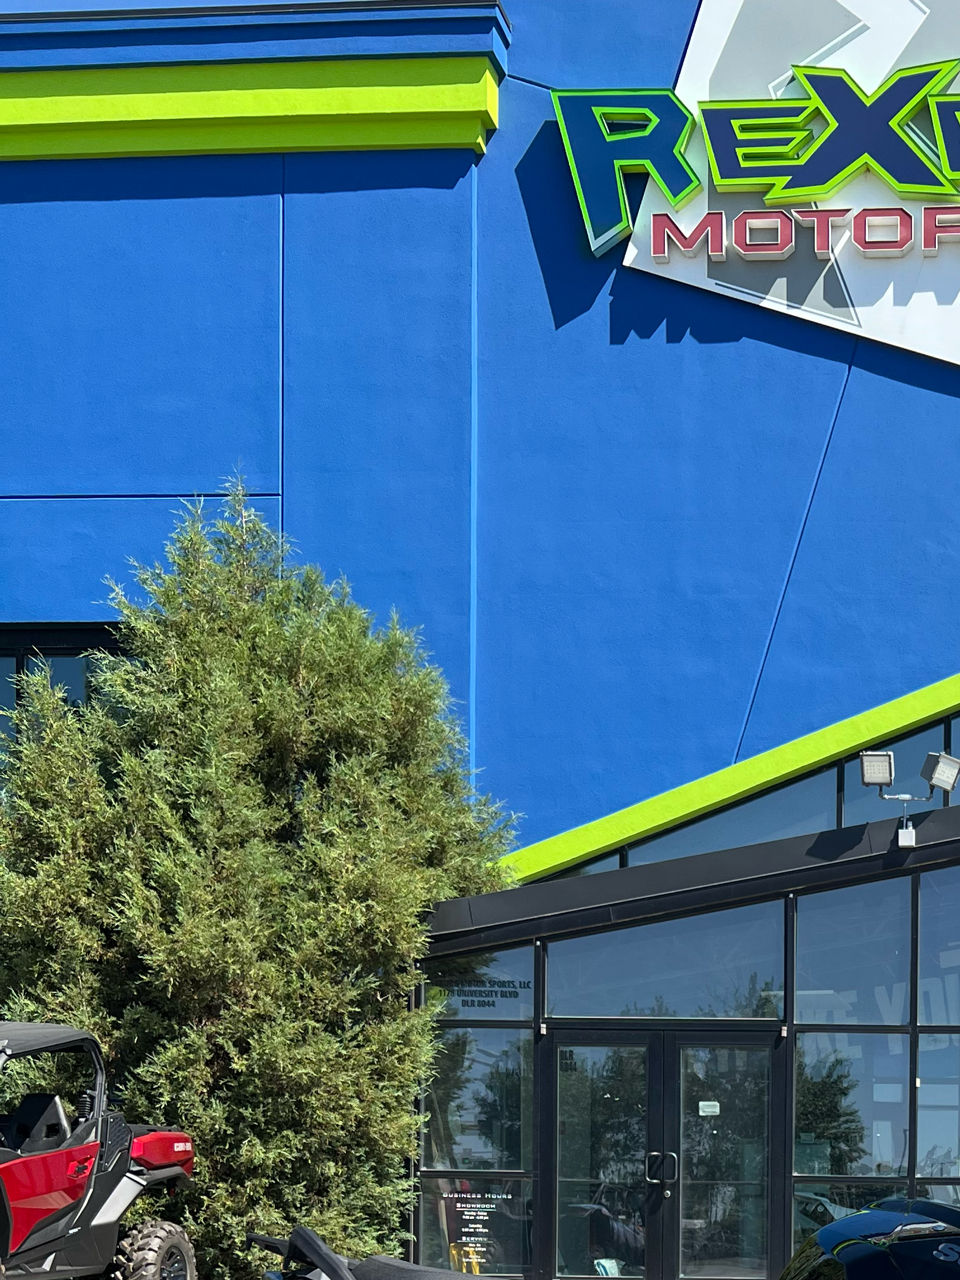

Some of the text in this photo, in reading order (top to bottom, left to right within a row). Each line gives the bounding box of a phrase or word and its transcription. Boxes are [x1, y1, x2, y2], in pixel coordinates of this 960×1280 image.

[488, 981, 517, 990] SPORTS,
[519, 981, 532, 989] LLC
[456, 989, 498, 998] UNIVERSITY
[500, 990, 520, 999] BLVD
[461, 999, 497, 1008] DLR 8044
